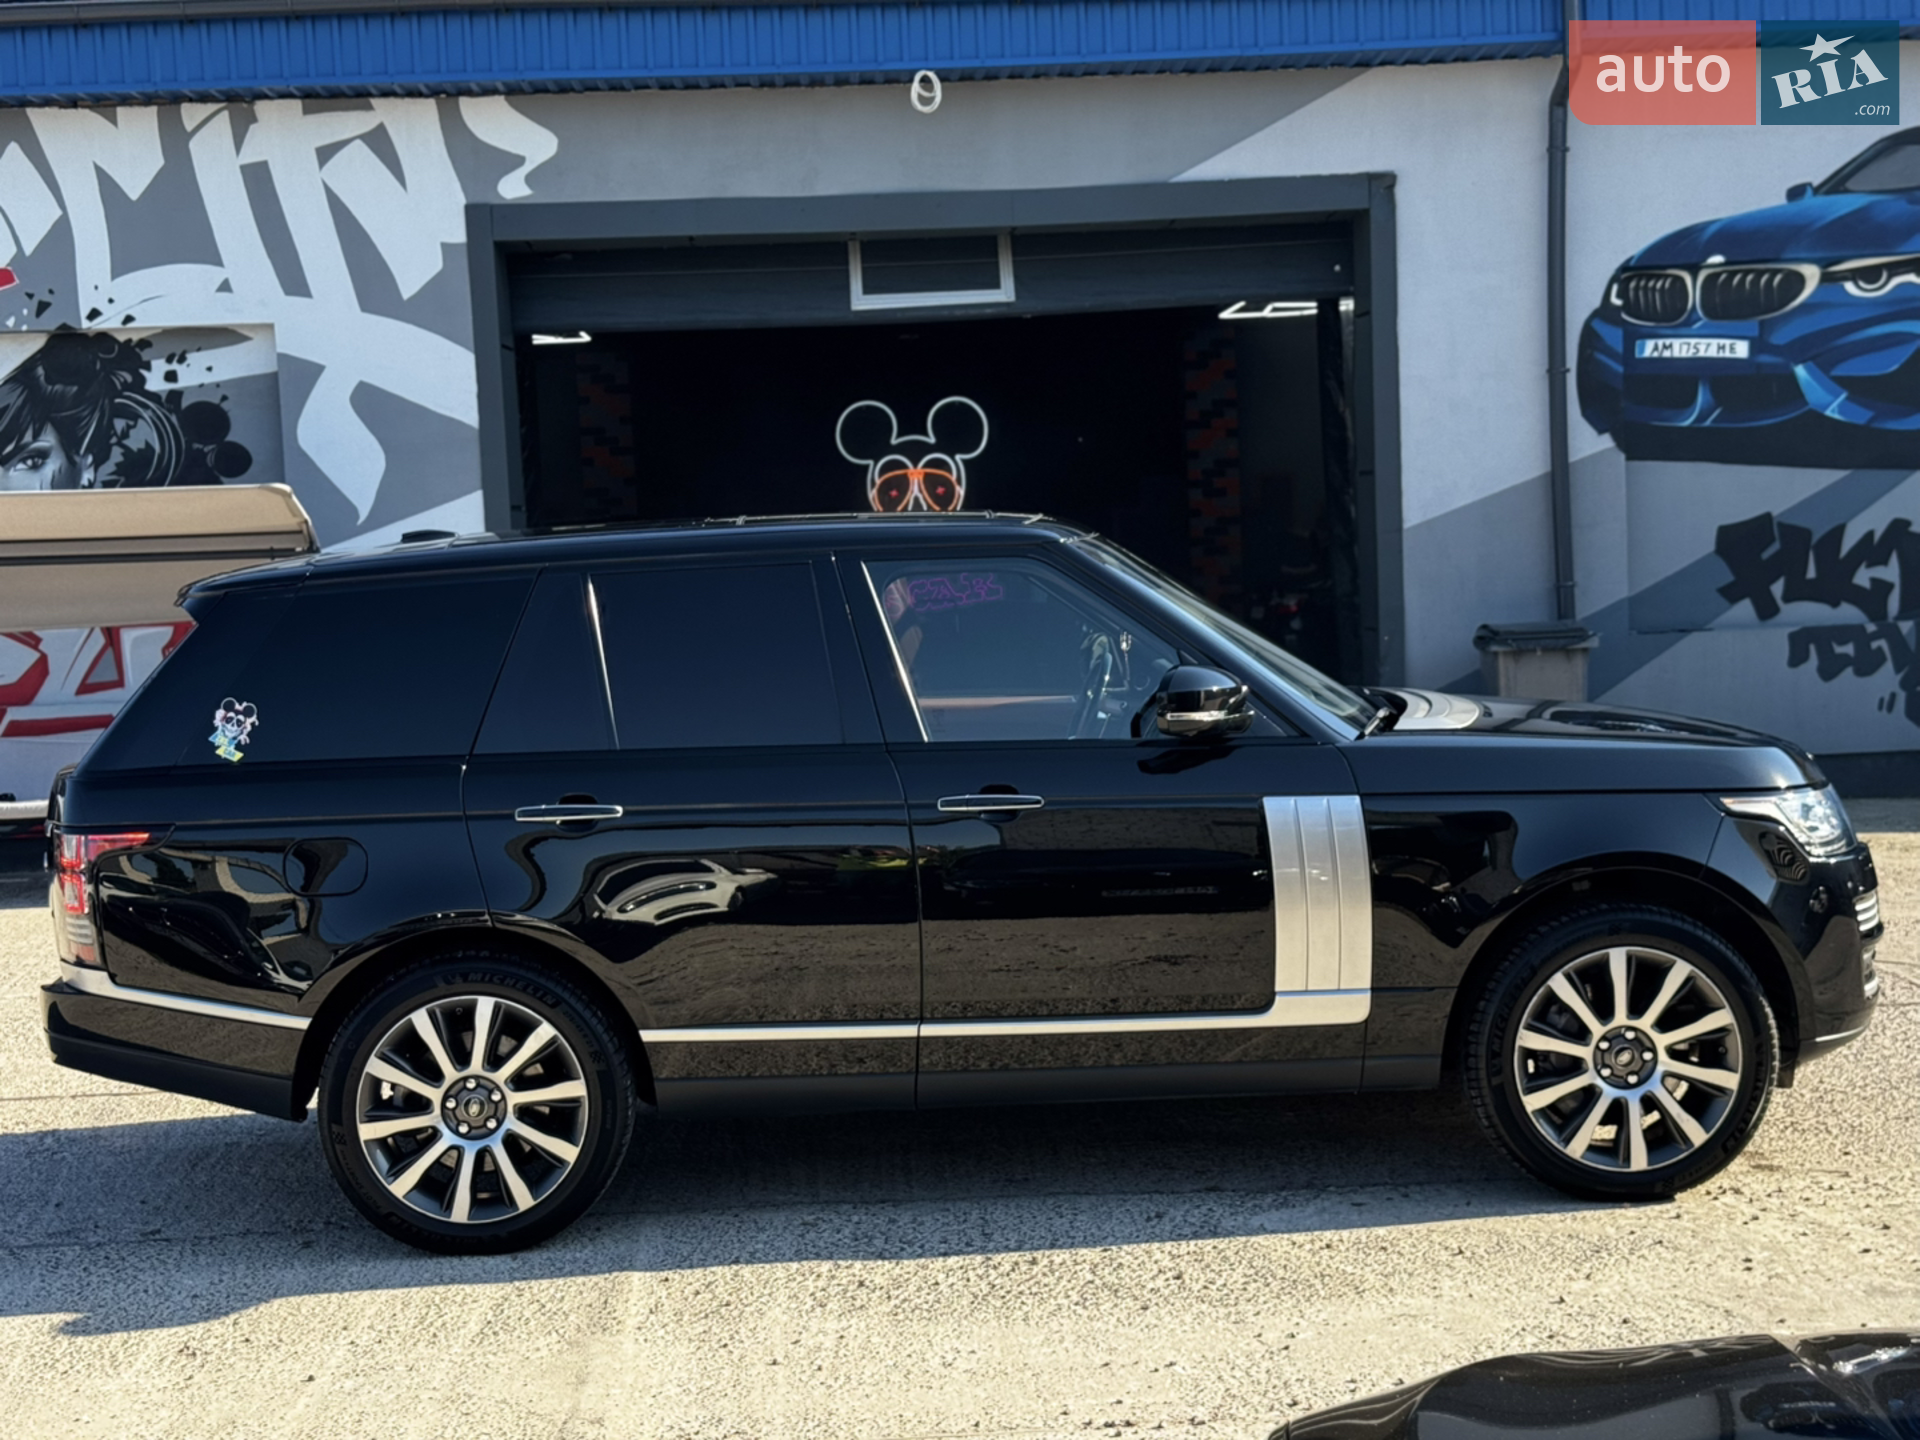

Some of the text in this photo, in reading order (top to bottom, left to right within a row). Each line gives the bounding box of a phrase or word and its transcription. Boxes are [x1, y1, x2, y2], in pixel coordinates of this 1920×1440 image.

[1649, 341, 1674, 357] AM
[1716, 341, 1737, 355] HE
[467, 972, 559, 1006] MICHELIN
